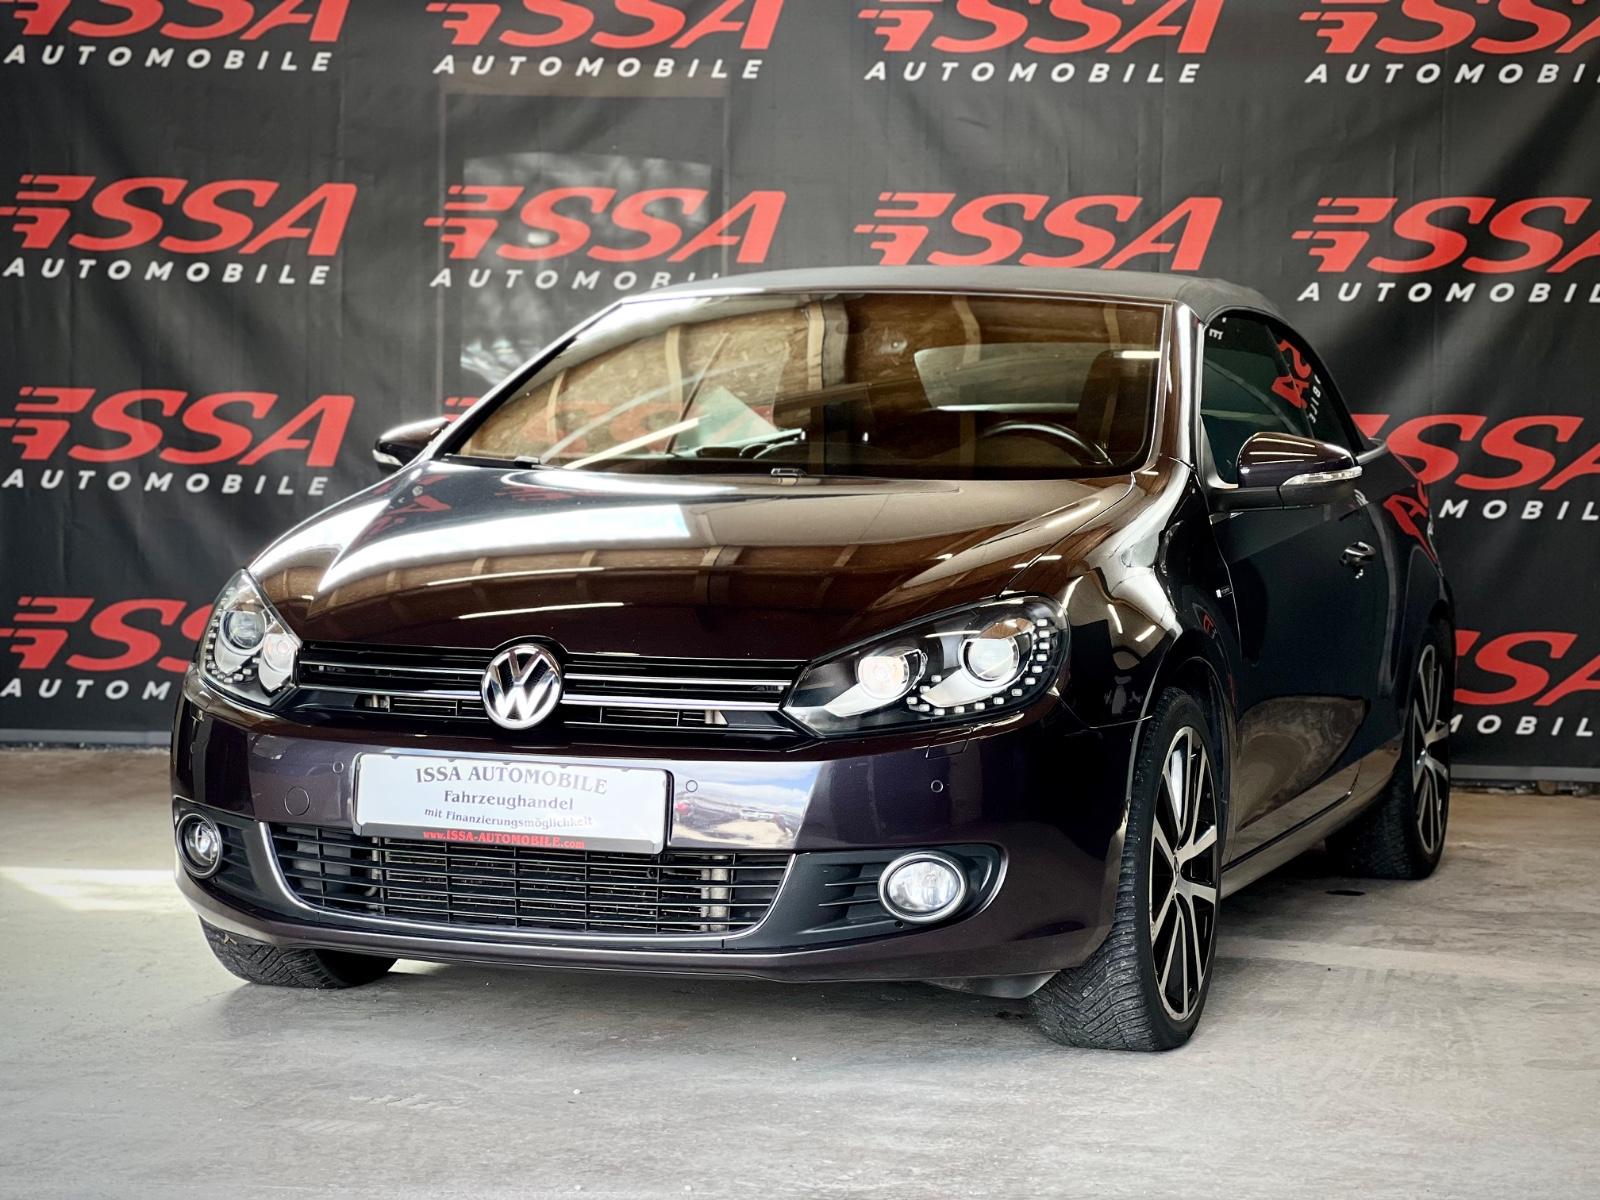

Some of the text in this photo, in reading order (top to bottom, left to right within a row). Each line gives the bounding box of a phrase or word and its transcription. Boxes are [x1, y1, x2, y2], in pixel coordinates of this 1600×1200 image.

[3, 45, 332, 72] AUTOMOBILE
[432, 54, 764, 79] AUTOMOBILE
[863, 61, 1200, 84] AUTOMOBILE
[1304, 63, 1600, 84] AUTOMOBI
[2, 257, 330, 285] AUTOMOBILE
[430, 268, 719, 291] AUTOMOB
[2, 469, 328, 496] AUTOMOBILE
[415, 766, 608, 795] ISSA AUTOMOBILE
[444, 790, 574, 811] Fahrzeughandel
[424, 807, 593, 830] mit Finanzierungsmöglichkeit
[423, 830, 585, 849] www.ISSA-AUTOMOBILE.com
